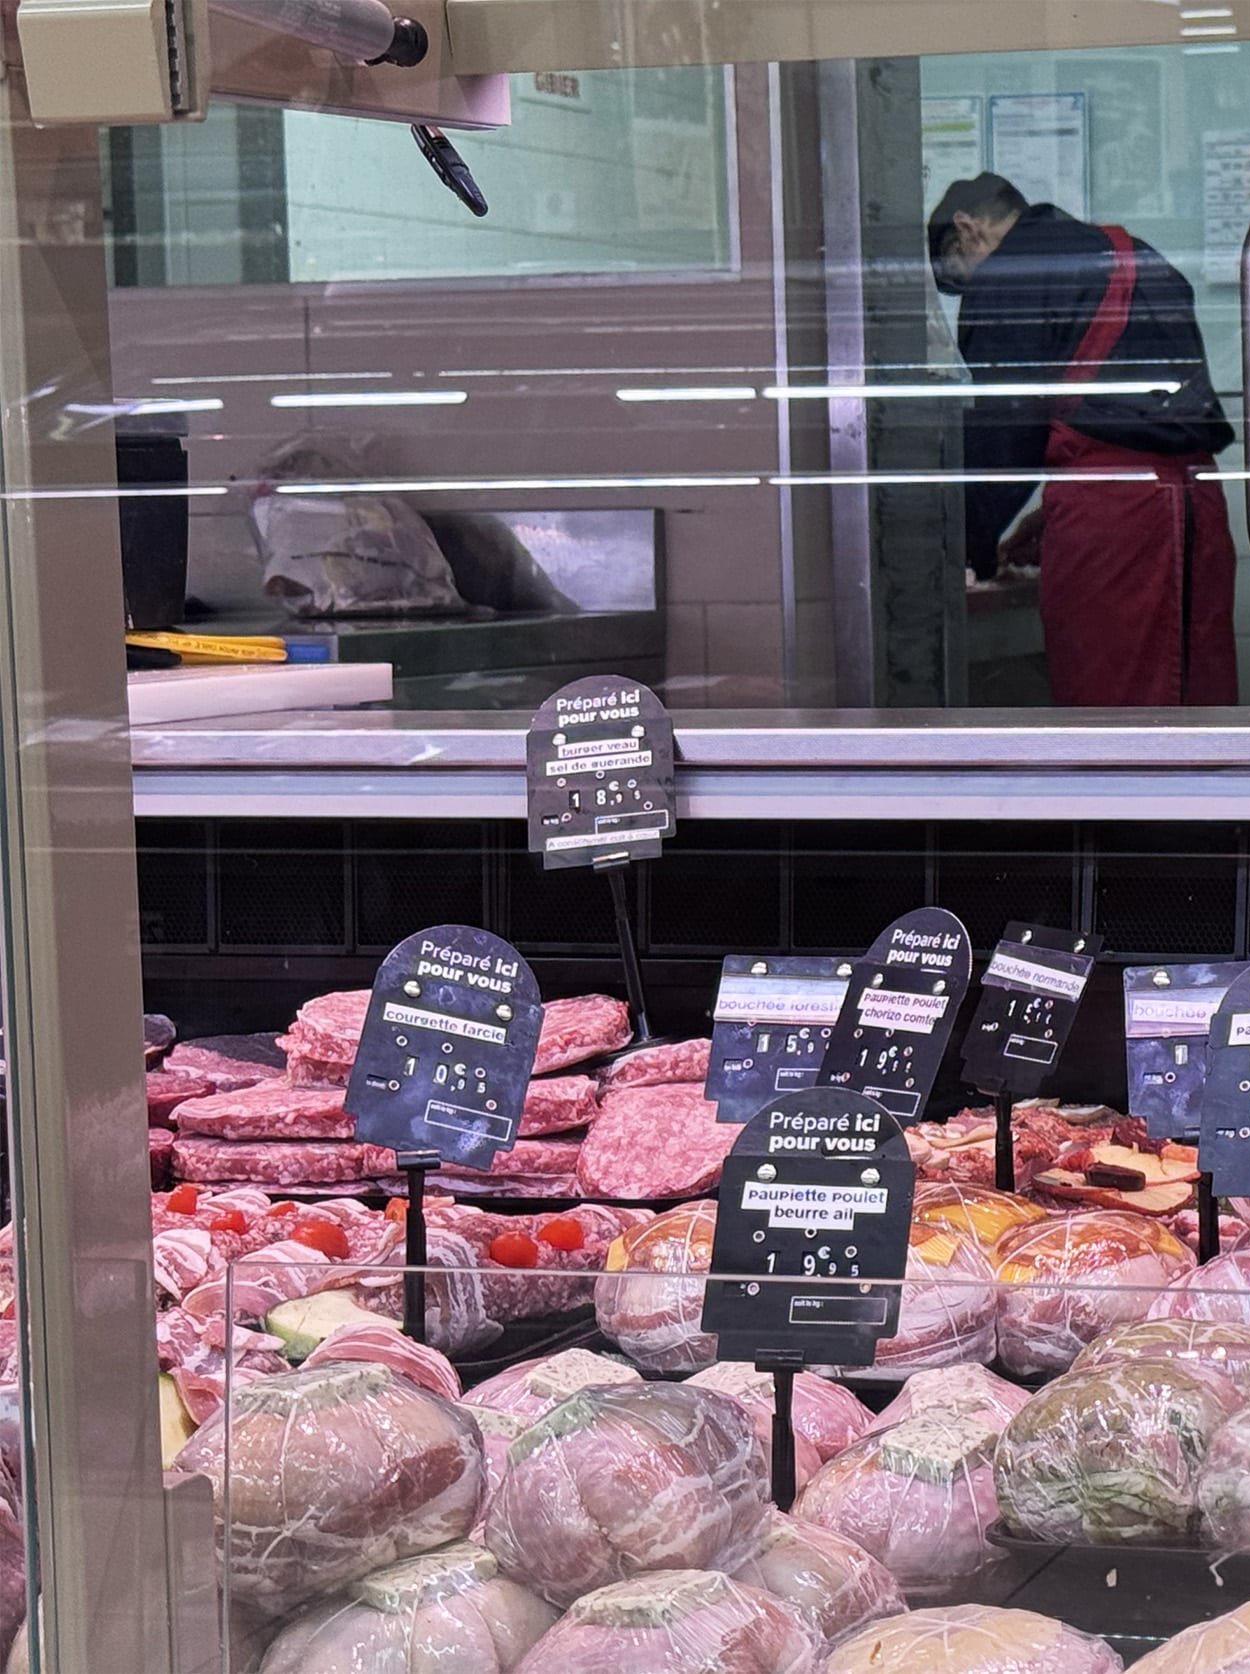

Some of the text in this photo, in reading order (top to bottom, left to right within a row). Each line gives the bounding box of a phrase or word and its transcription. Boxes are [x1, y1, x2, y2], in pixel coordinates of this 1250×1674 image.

[557, 689, 640, 712] Préparé ici
[558, 706, 639, 728] pour vous
[607, 741, 637, 751] veau
[891, 929, 960, 950] Préparé ici
[420, 940, 519, 977] Préparé ici
[887, 949, 953, 967] pour vous
[418, 960, 512, 994] pour vous
[386, 1009, 459, 1032] courgette
[864, 1007, 902, 1021] chorizo
[769, 1111, 881, 1133] Préparé ici
[769, 1135, 876, 1152] pour vous
[748, 1187, 886, 1204] paupiette poulet
[774, 1206, 854, 1220] beurre ail
